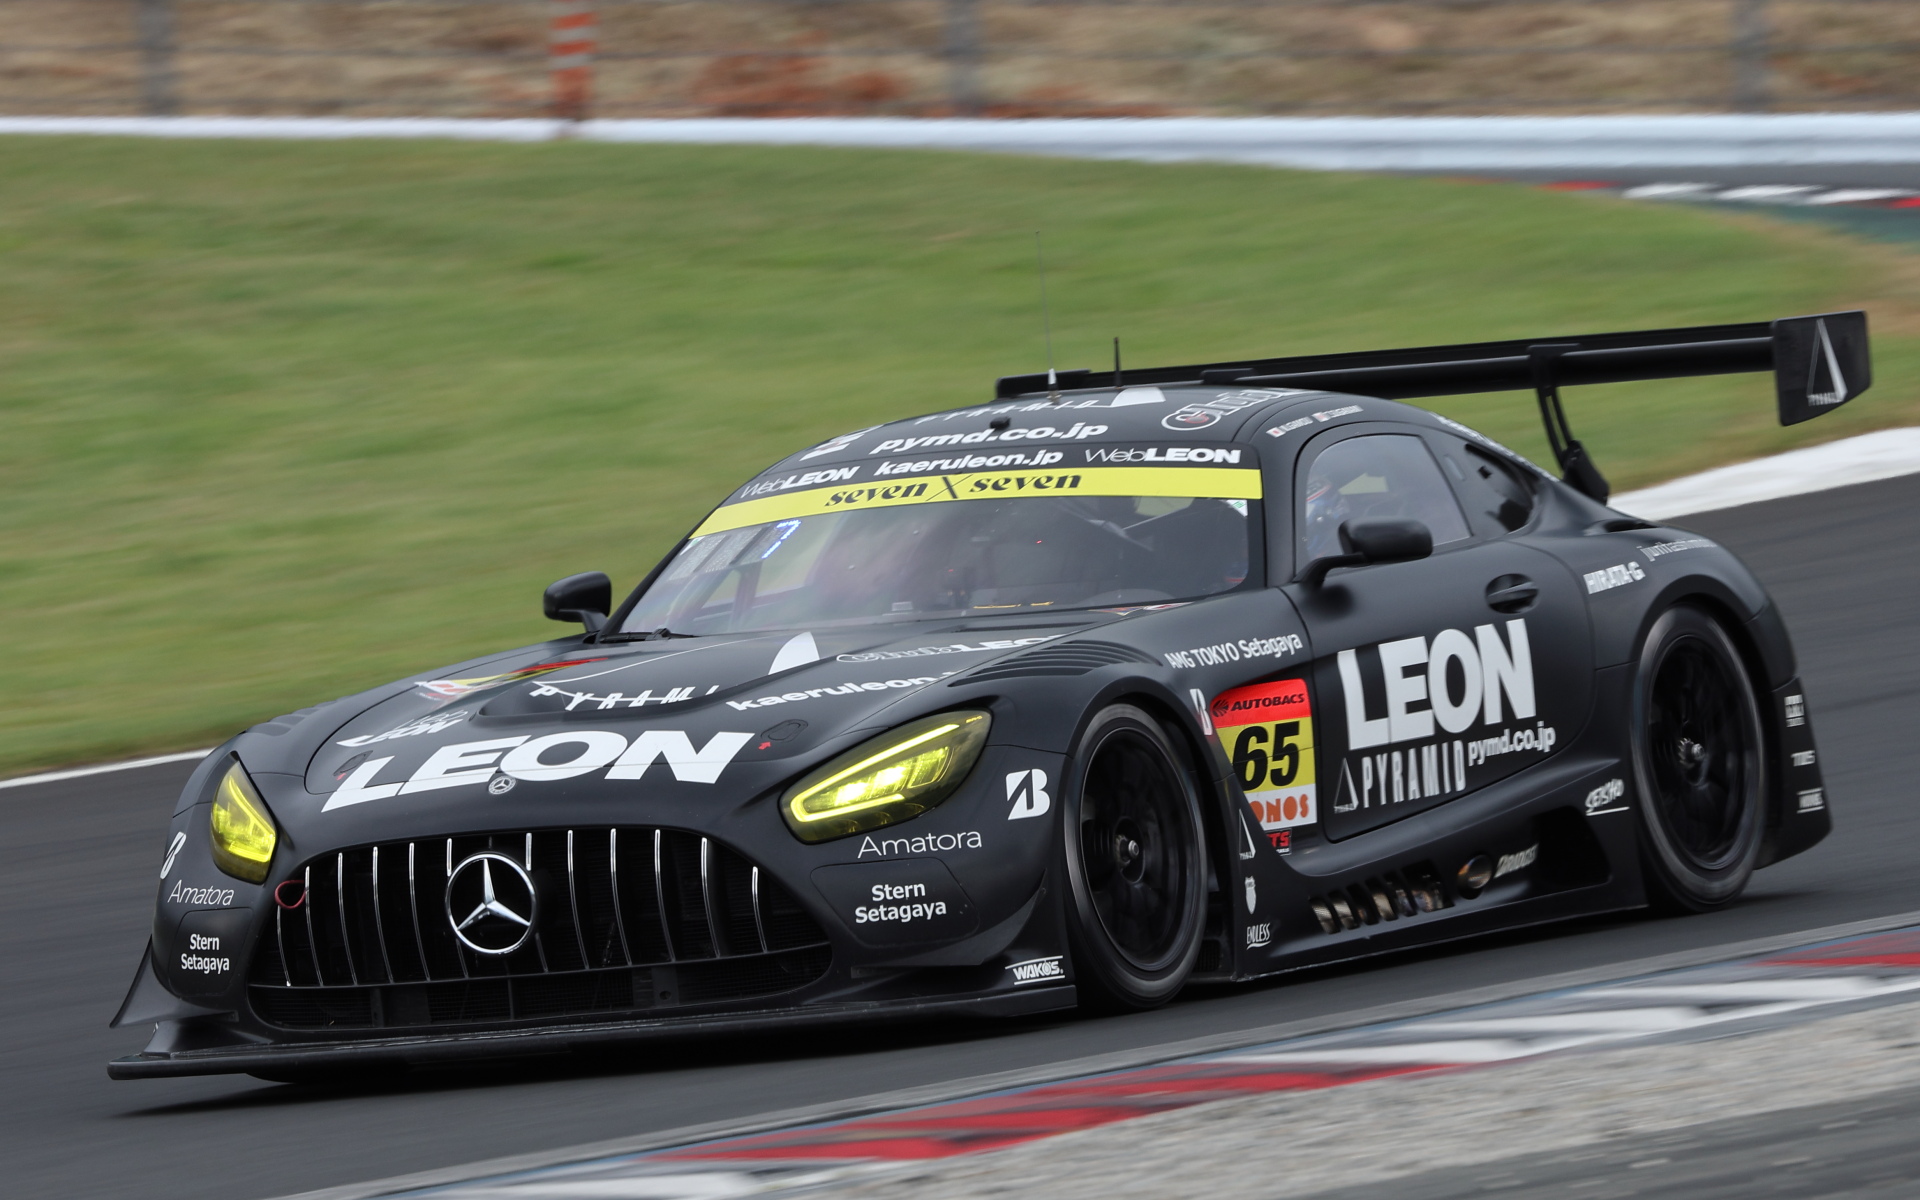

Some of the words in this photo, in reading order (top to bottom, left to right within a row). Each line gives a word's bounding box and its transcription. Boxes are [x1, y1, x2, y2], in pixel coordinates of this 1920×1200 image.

[868, 421, 1109, 456] pymd.co.jp
[873, 448, 1065, 478] kaeruleon.jp
[1085, 447, 1242, 465] WebLEON
[740, 465, 861, 500] WebLEON
[824, 482, 930, 507] seven
[969, 473, 1083, 494] seven
[1164, 651, 1197, 670] AMG
[1194, 641, 1240, 667] TOKYO
[1237, 632, 1303, 660] Setagaya
[529, 682, 720, 712] PYRAMI
[726, 671, 963, 711] kaeruleon.
[1337, 618, 1536, 751] LEON
[1230, 693, 1306, 712] AUTOBACS
[1232, 720, 1300, 793] 65
[1467, 720, 1556, 767] pymd.co.jp
[321, 729, 756, 813] LEON
[1361, 740, 1466, 809] PYRAMID
[1249, 793, 1310, 825] ONOS
[858, 831, 982, 859] Amatora
[167, 879, 235, 906] Amatora
[871, 882, 926, 902] Stern
[855, 901, 947, 924] Setagaya
[189, 933, 220, 951] Stern
[1246, 922, 1271, 944] ENDLESS
[181, 953, 230, 975] Setagaya
